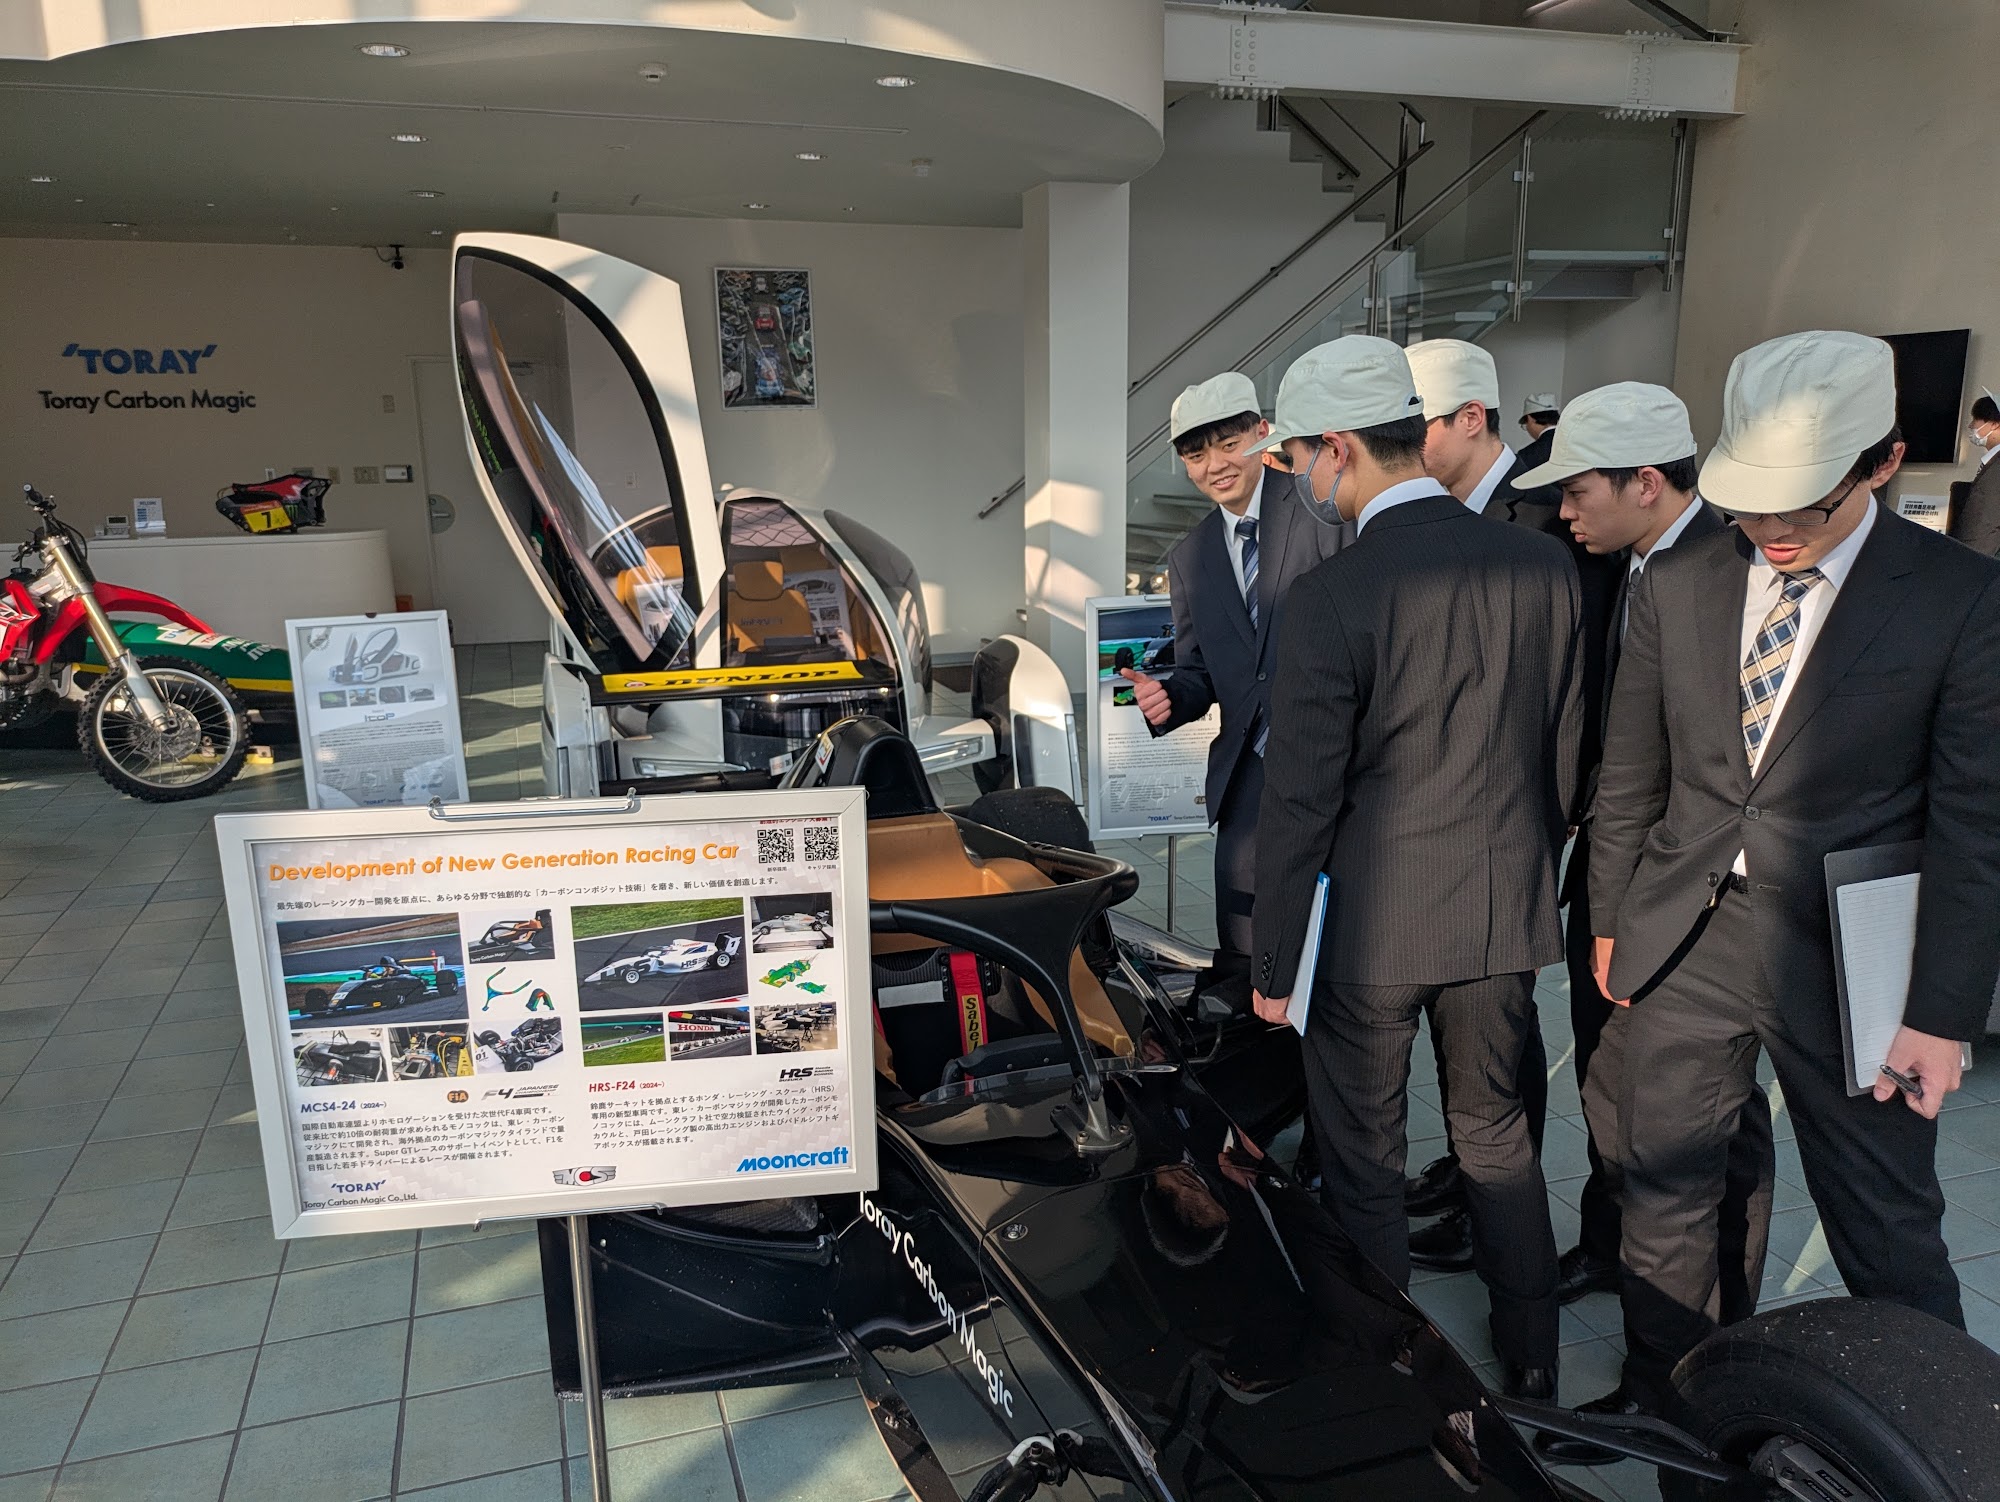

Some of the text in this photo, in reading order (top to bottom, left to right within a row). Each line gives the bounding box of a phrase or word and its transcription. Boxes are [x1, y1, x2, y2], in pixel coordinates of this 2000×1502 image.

[38, 389, 257, 414] Toray Carbon Magic
[260, 511, 272, 528] 7
[663, 669, 840, 687] DUNLOP
[269, 843, 740, 881] Development of New Generation Racing Car
[677, 1023, 715, 1031] HONDA
[475, 1051, 487, 1061] 01
[780, 1067, 814, 1079] HRS
[481, 1088, 514, 1101] F4
[588, 1080, 636, 1093] HRS-F24
[300, 1100, 356, 1113] MCS4-24
[736, 1146, 849, 1172] Mooncraft
[303, 1193, 418, 1209] Toray Carbon Magic Co.,Ltd.
[904, 1231, 957, 1335] Carbon
[960, 1311, 1014, 1419] Magic
